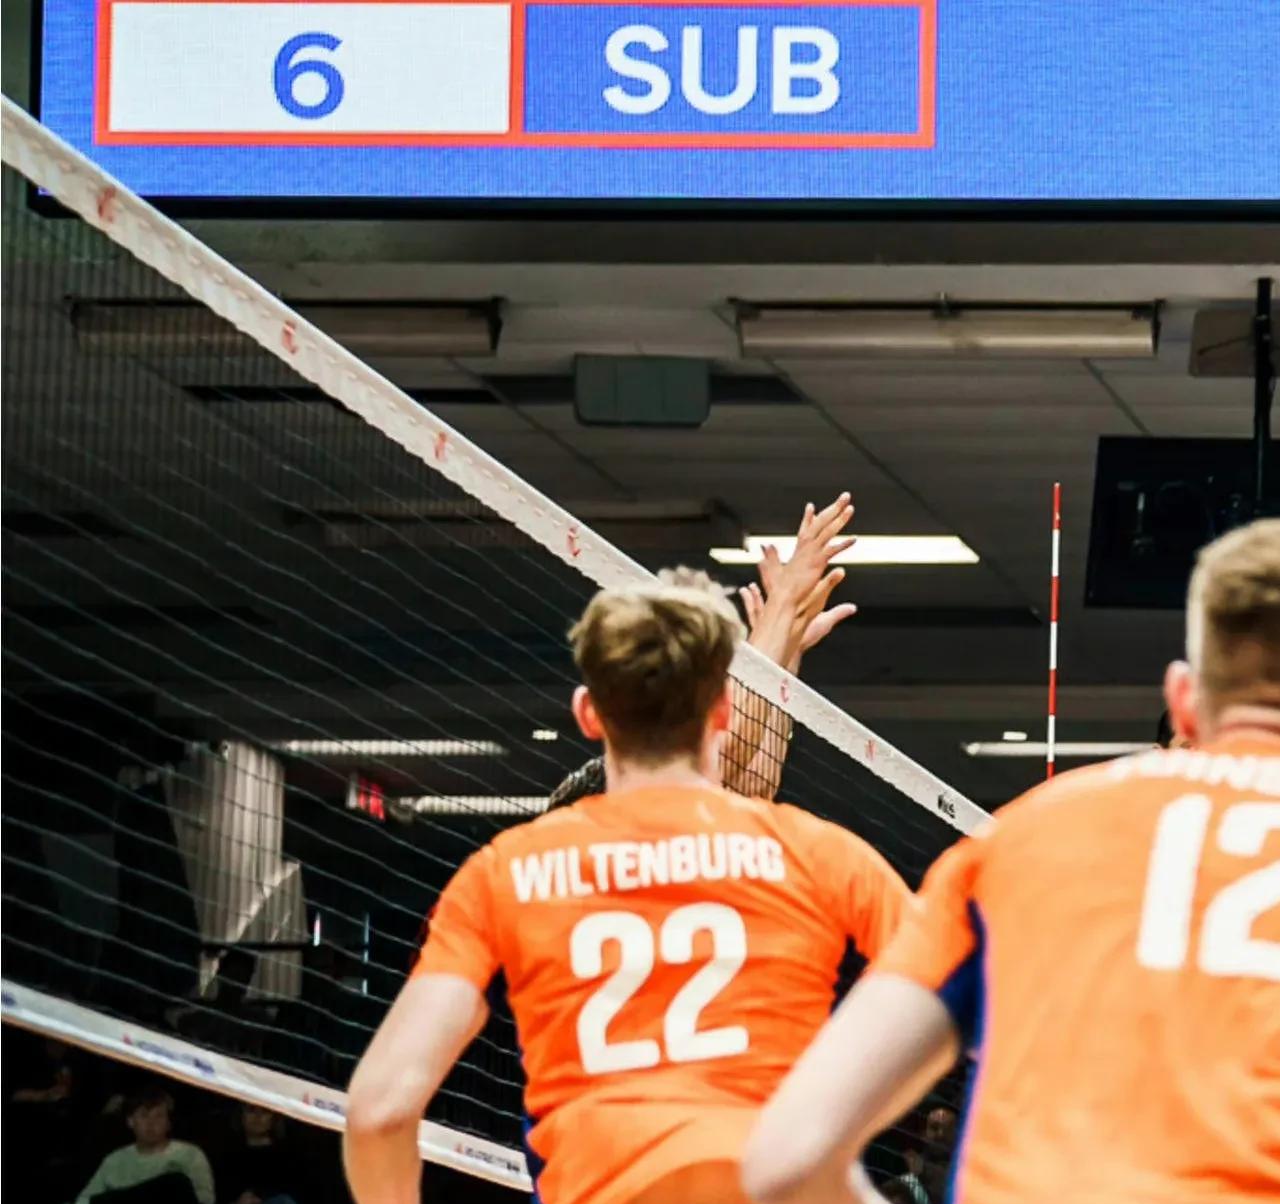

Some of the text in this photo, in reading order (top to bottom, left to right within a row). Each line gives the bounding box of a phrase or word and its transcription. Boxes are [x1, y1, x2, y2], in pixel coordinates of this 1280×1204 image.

[271, 25, 840, 120] 6 SUB
[510, 832, 786, 902] WILTENBURG
[570, 902, 749, 1074] 22
